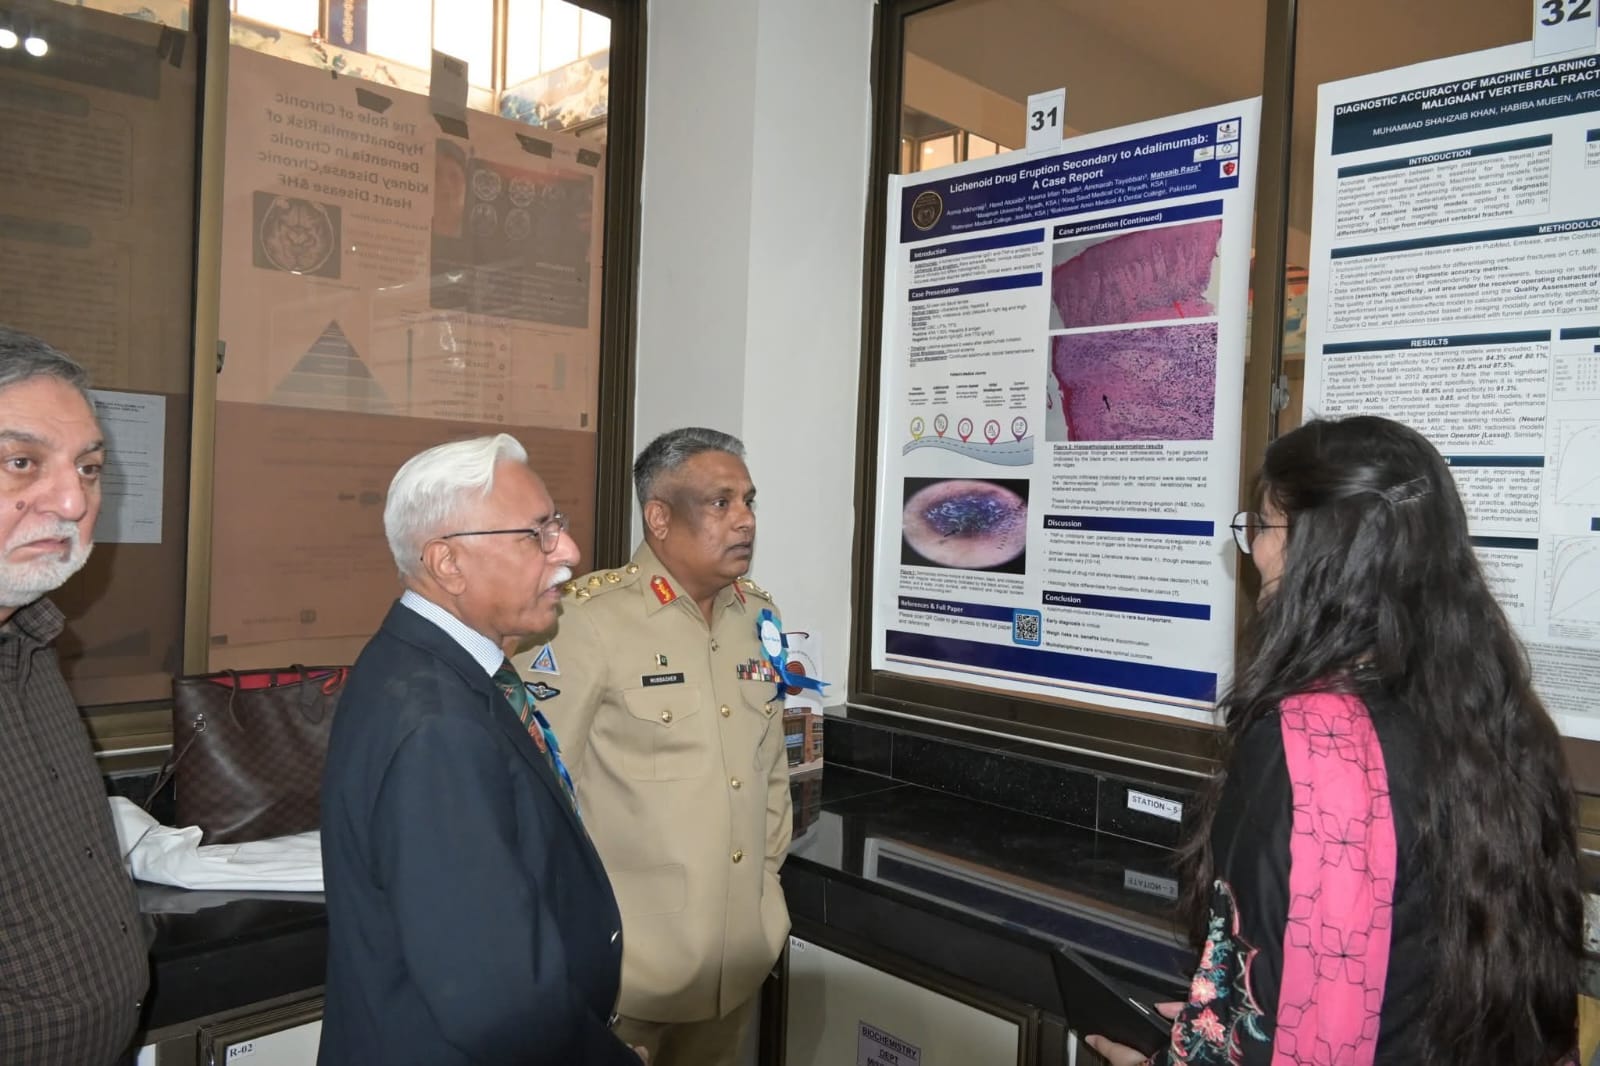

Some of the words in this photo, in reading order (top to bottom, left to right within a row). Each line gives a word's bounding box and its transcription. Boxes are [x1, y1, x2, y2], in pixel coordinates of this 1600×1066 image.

[1541, 0, 1591, 26] 32
[1336, 95, 1397, 115] DIAGNOSTIC
[1400, 84, 1459, 103] ACCURACY
[1462, 81, 1477, 90] OF
[1480, 70, 1532, 88] MACHINE
[1534, 58, 1596, 77] LEARNING
[1422, 90, 1486, 110] MALIGNANT
[1489, 77, 1557, 97] VERTEBRAL
[1030, 106, 1058, 131] 31
[1372, 121, 1422, 136] MUHAMMAD
[1425, 112, 1468, 127] SHAHZAIB
[1471, 106, 1498, 120] KHAN,
[1501, 100, 1534, 113] HABIBA
[1537, 94, 1573, 108] MUEEN,
[950, 176, 992, 193] Lichenoid
[995, 171, 1017, 184] Drug
[1019, 164, 1060, 180] Eruption
[1062, 148, 1117, 171] Secondary
[1120, 149, 1132, 160] to
[1134, 133, 1209, 156] Adalimumab:
[1408, 149, 1472, 166] INTRODUCTION
[1032, 180, 1040, 190] A
[1041, 174, 1066, 188] Case
[1068, 168, 1103, 186] Report
[1150, 168, 1180, 180] Mahzaib
[1058, 226, 1074, 236] Case
[1075, 218, 1118, 234] presentation
[1120, 212, 1163, 227] (Continued)
[914, 247, 947, 258] Introduction
[911, 290, 924, 298] Case
[925, 286, 960, 297] Presentation
[1410, 338, 1448, 347] RESULTS
[1047, 519, 1082, 528] Discussion
[900, 600, 930, 609] References
[947, 605, 964, 613] Paper
[1045, 594, 1082, 604] Conclusion
[1131, 795, 1165, 810] STATION
[229, 1043, 253, 1057] R-02
[862, 1026, 917, 1057] BIOCHEMISTRY
